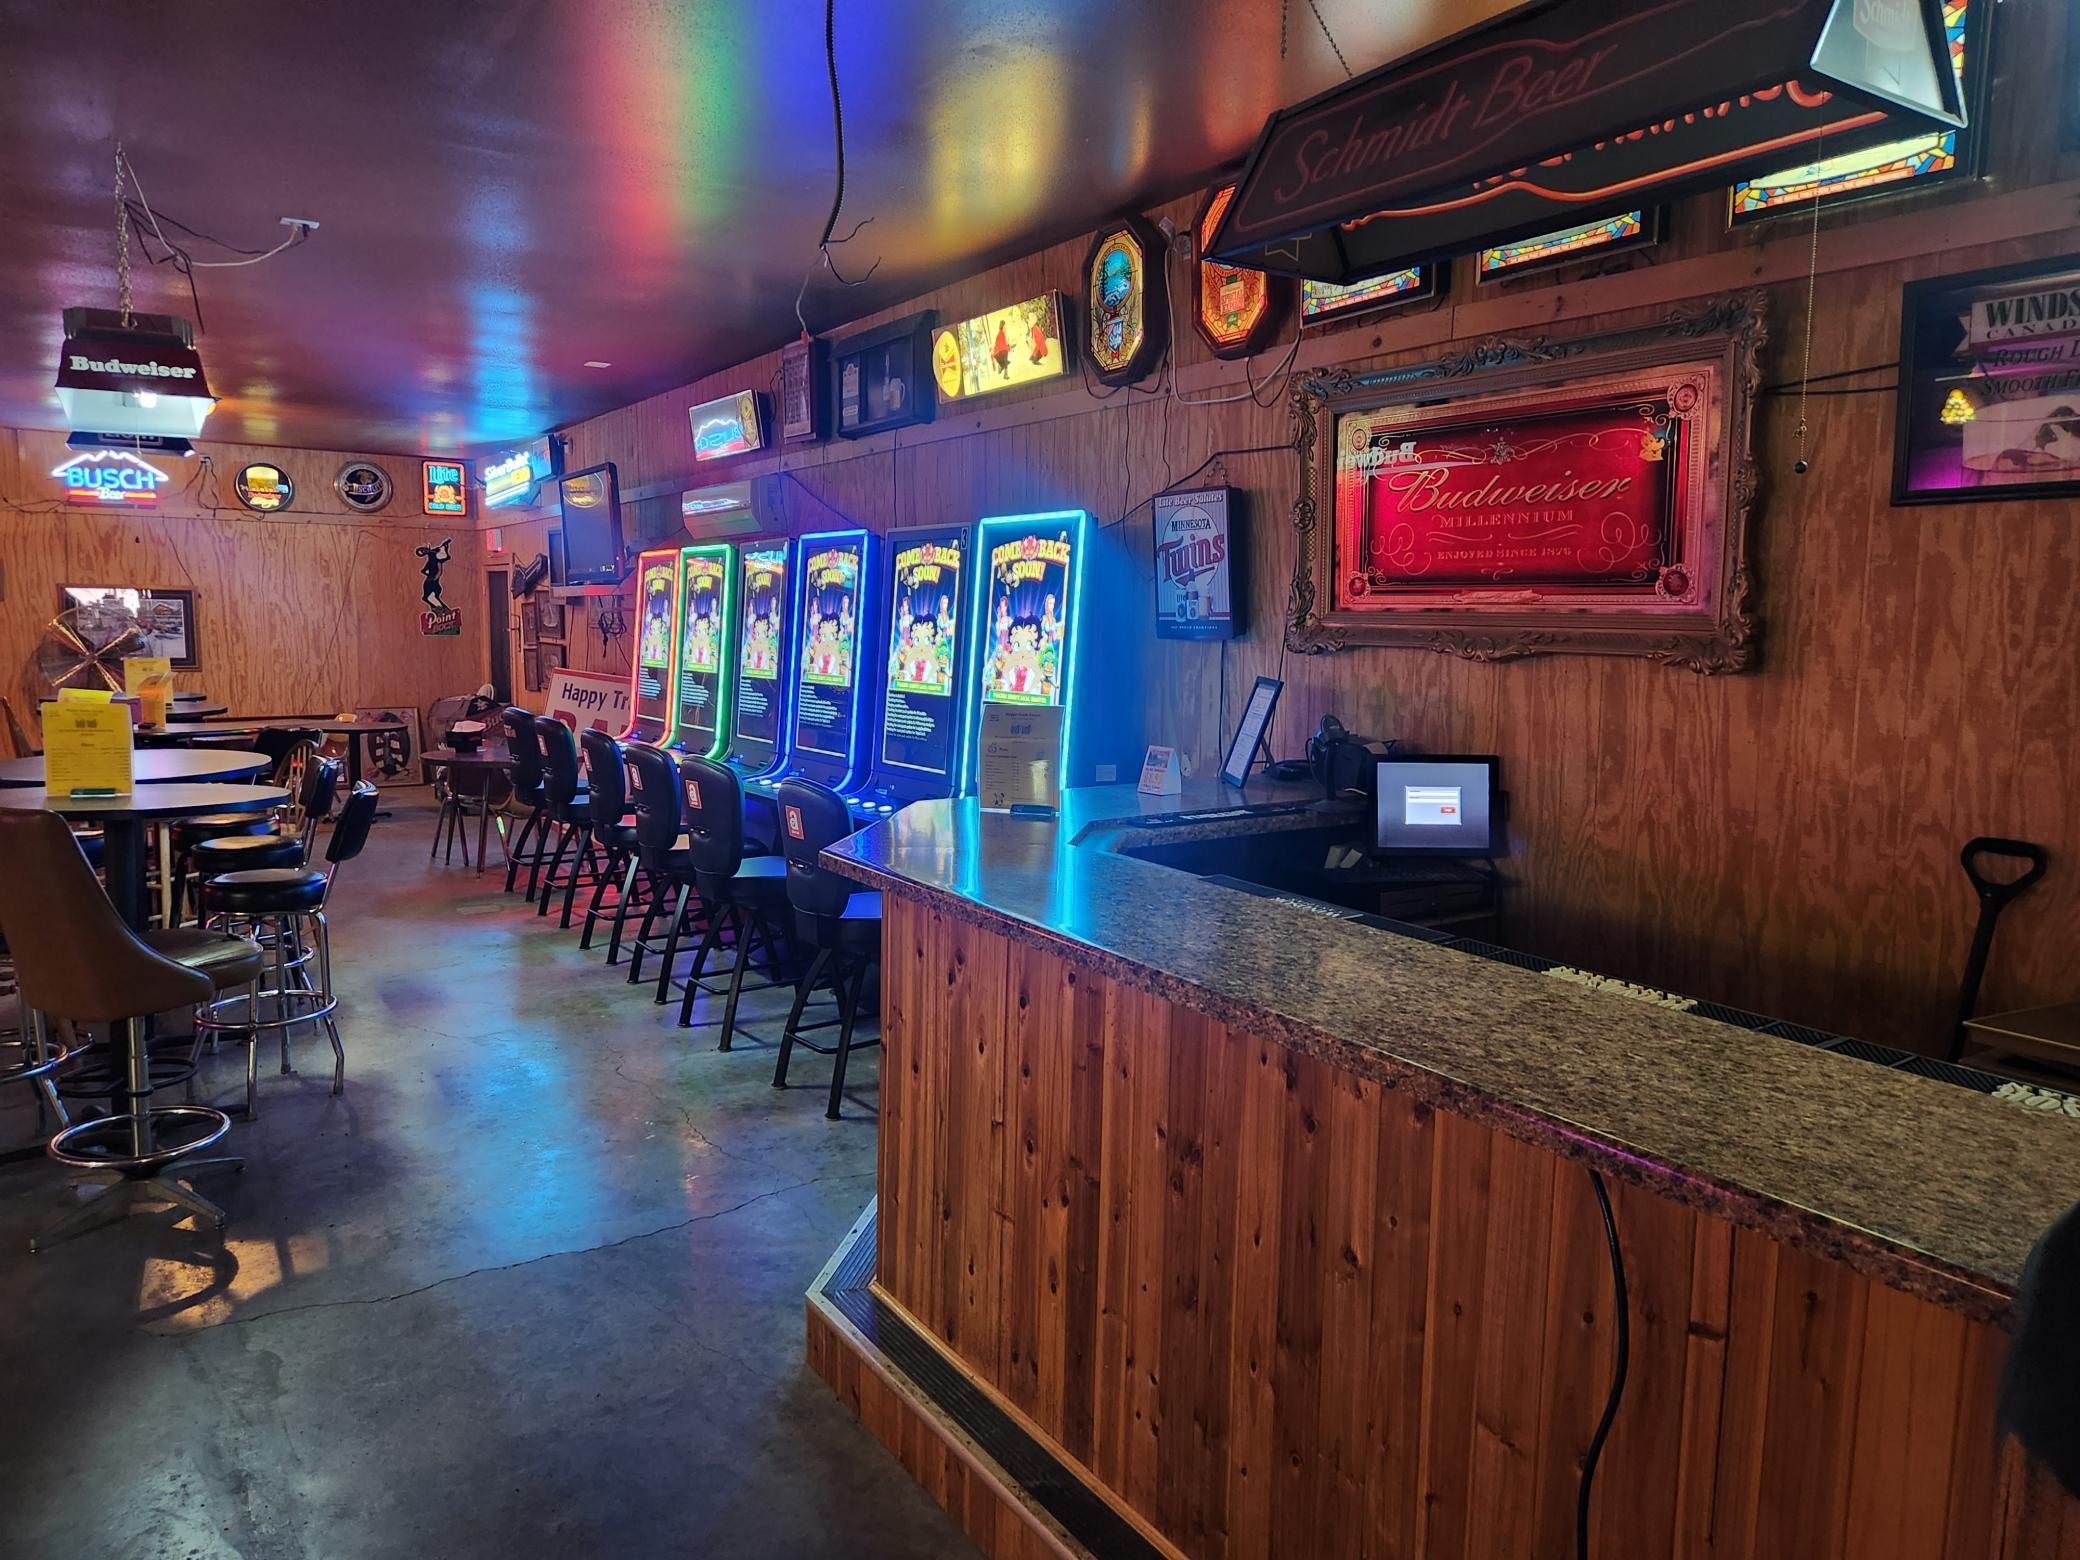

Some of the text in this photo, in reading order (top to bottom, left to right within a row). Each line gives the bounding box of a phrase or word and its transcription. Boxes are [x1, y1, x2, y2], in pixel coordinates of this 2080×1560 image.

[1274, 80, 1467, 203] Schmidt
[1472, 43, 1619, 130] Beer
[69, 355, 198, 379] Budweiser
[1994, 346, 2065, 368] ROUGH
[1981, 375, 2059, 396] SMOOTH
[66, 466, 156, 490] BUSCH
[429, 466, 458, 484] Lite
[98, 487, 126, 500] Beer
[1389, 466, 1632, 513] Budweiser
[1158, 493, 1224, 509] Lite Beer Salutes
[1171, 518, 1211, 532] MINNESOTA
[1440, 510, 1574, 529] MILLENNIUM
[896, 546, 960, 570] COME BACK
[992, 540, 1071, 567] COME BACK
[1157, 534, 1225, 585] Twins
[913, 565, 942, 584] SOON!
[1013, 561, 1047, 583] SOON!
[425, 611, 456, 629] Point
[561, 682, 607, 711] Happy
